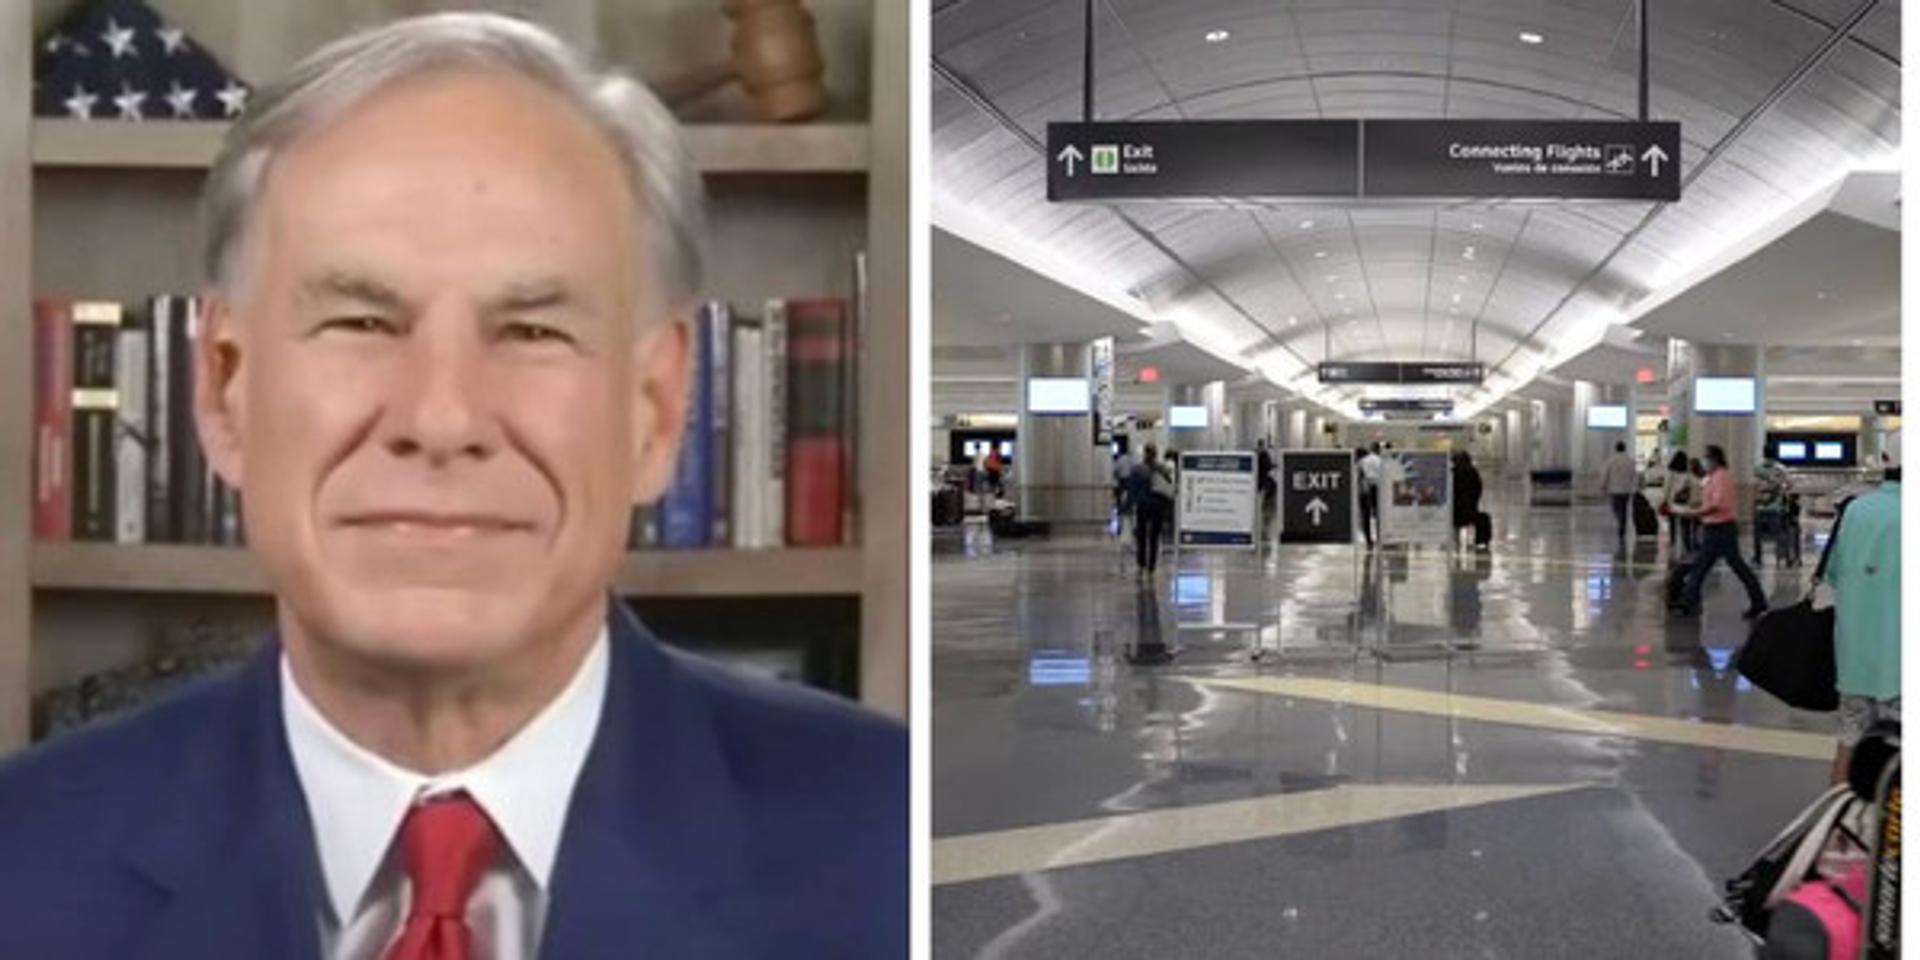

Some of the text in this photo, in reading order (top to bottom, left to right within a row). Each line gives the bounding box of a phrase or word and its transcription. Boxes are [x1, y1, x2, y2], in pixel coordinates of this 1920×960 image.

[1123, 143, 1153, 159] Exit
[1449, 143, 1601, 162] Connecting Flights
[1292, 471, 1341, 490] EXIT
